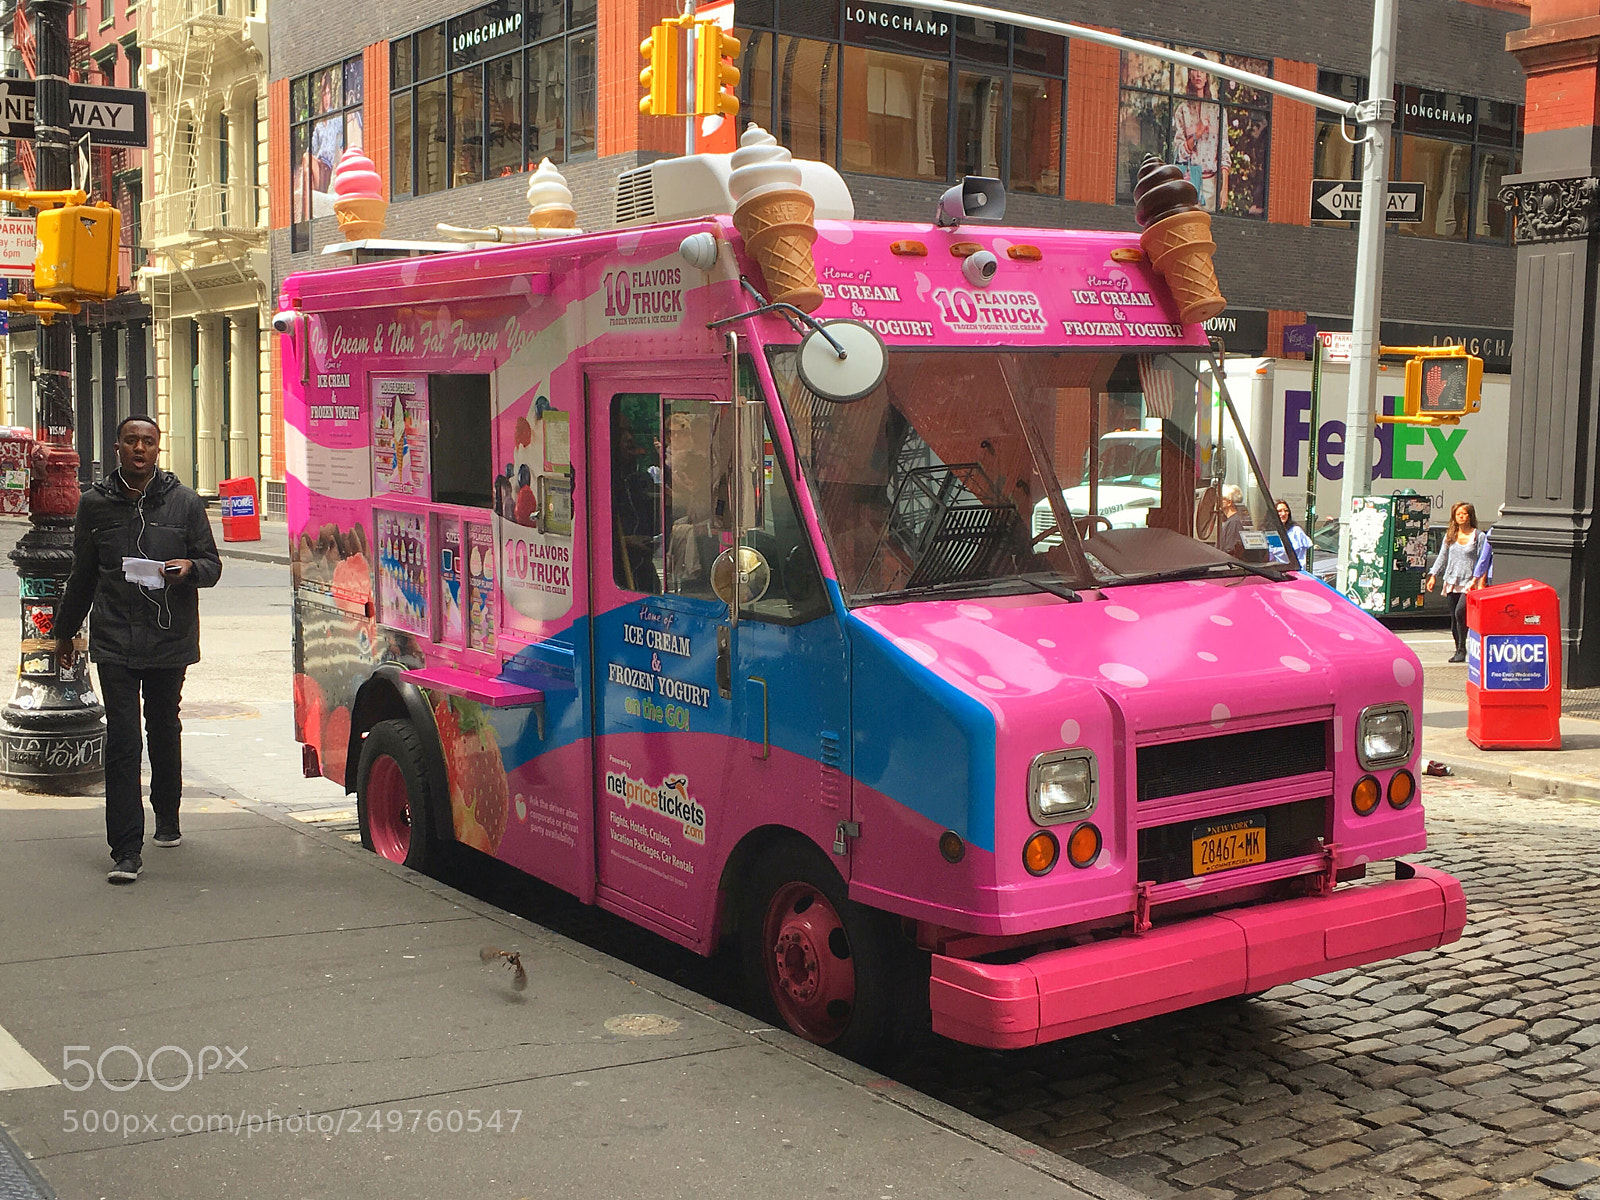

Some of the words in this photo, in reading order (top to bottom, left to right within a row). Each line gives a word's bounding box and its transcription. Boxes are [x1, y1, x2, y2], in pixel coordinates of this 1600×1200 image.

[846, 7, 949, 37] LONGCHAMP
[453, 13, 522, 53] LONGCHAMP
[0, 98, 35, 121] NE
[69, 103, 122, 128] WAY
[1405, 103, 1473, 125] LONGCHAMP
[1332, 193, 1362, 209] ONE
[1387, 195, 1409, 210] AY
[0, 223, 34, 235] ARKIN
[16, 239, 36, 249] Frida
[3, 249, 21, 258] 6pm
[823, 267, 854, 280] Home
[858, 270, 871, 283] of
[1088, 275, 1115, 287] Home
[1117, 277, 1128, 289] of
[603, 270, 631, 317] 10
[632, 267, 681, 288] FLAVORS
[838, 284, 900, 302] CREAM
[1072, 290, 1099, 304] ICE
[1101, 291, 1153, 306] CREAM
[632, 289, 682, 315] TRUCK
[851, 302, 866, 317] &
[935, 290, 979, 324] 10
[975, 293, 1037, 306] FLAVORS
[651, 316, 660, 324] ICE
[660, 315, 677, 323] CREAM
[979, 307, 1046, 324] TRUCK
[1113, 307, 1126, 321] &
[864, 319, 933, 337] YOGURT
[1062, 321, 1123, 336] FROZEN
[1124, 322, 1183, 338] YOGURT
[1201, 317, 1237, 332] ROWN
[312, 326, 328, 355] Ice
[331, 325, 369, 358] Cream
[373, 324, 384, 353] &
[388, 322, 416, 355] Non
[420, 320, 445, 358] Fat
[450, 319, 499, 361] Frozen
[505, 315, 542, 359] Yog
[1432, 335, 1513, 357] NGCH
[317, 374, 328, 388] ICE
[328, 373, 350, 388] CREAM
[331, 390, 337, 403] &
[310, 405, 334, 419] FROZEN
[334, 405, 360, 419] YOGURT
[1282, 390, 1469, 481] FedEx
[1098, 503, 1124, 515] 201971
[505, 538, 529, 580] 10
[529, 543, 569, 563] FLAVORS
[530, 561, 570, 588] TRUCK
[639, 605, 661, 621] Home
[663, 613, 674, 629] of
[623, 623, 644, 646] ICE
[646, 629, 691, 657] CREAM
[651, 652, 661, 672] &
[1493, 643, 1544, 663] VOICE
[608, 663, 655, 692] FROZEN
[657, 676, 710, 708] YOGURT
[625, 696, 641, 717] on
[642, 697, 664, 724] the
[665, 703, 690, 732] GO!
[540, 798, 549, 810] the
[607, 775, 704, 827] netpricetickets
[530, 823, 545, 837] party
[556, 819, 562, 828] or
[562, 821, 579, 834] privat
[610, 810, 630, 829] Flights,
[630, 819, 649, 838] Hotels,
[649, 828, 672, 848] Cruises,
[684, 824, 704, 841] .com
[1212, 825, 1230, 834] NEW
[1230, 820, 1248, 831] YORK
[610, 827, 634, 847] Vacation
[634, 838, 661, 861] Packages,
[661, 850, 672, 864] Car
[672, 855, 695, 874] Rentals
[1201, 835, 1237, 865] 28467
[1245, 831, 1260, 856] MK
[1210, 858, 1248, 870] COMMERCIAL
